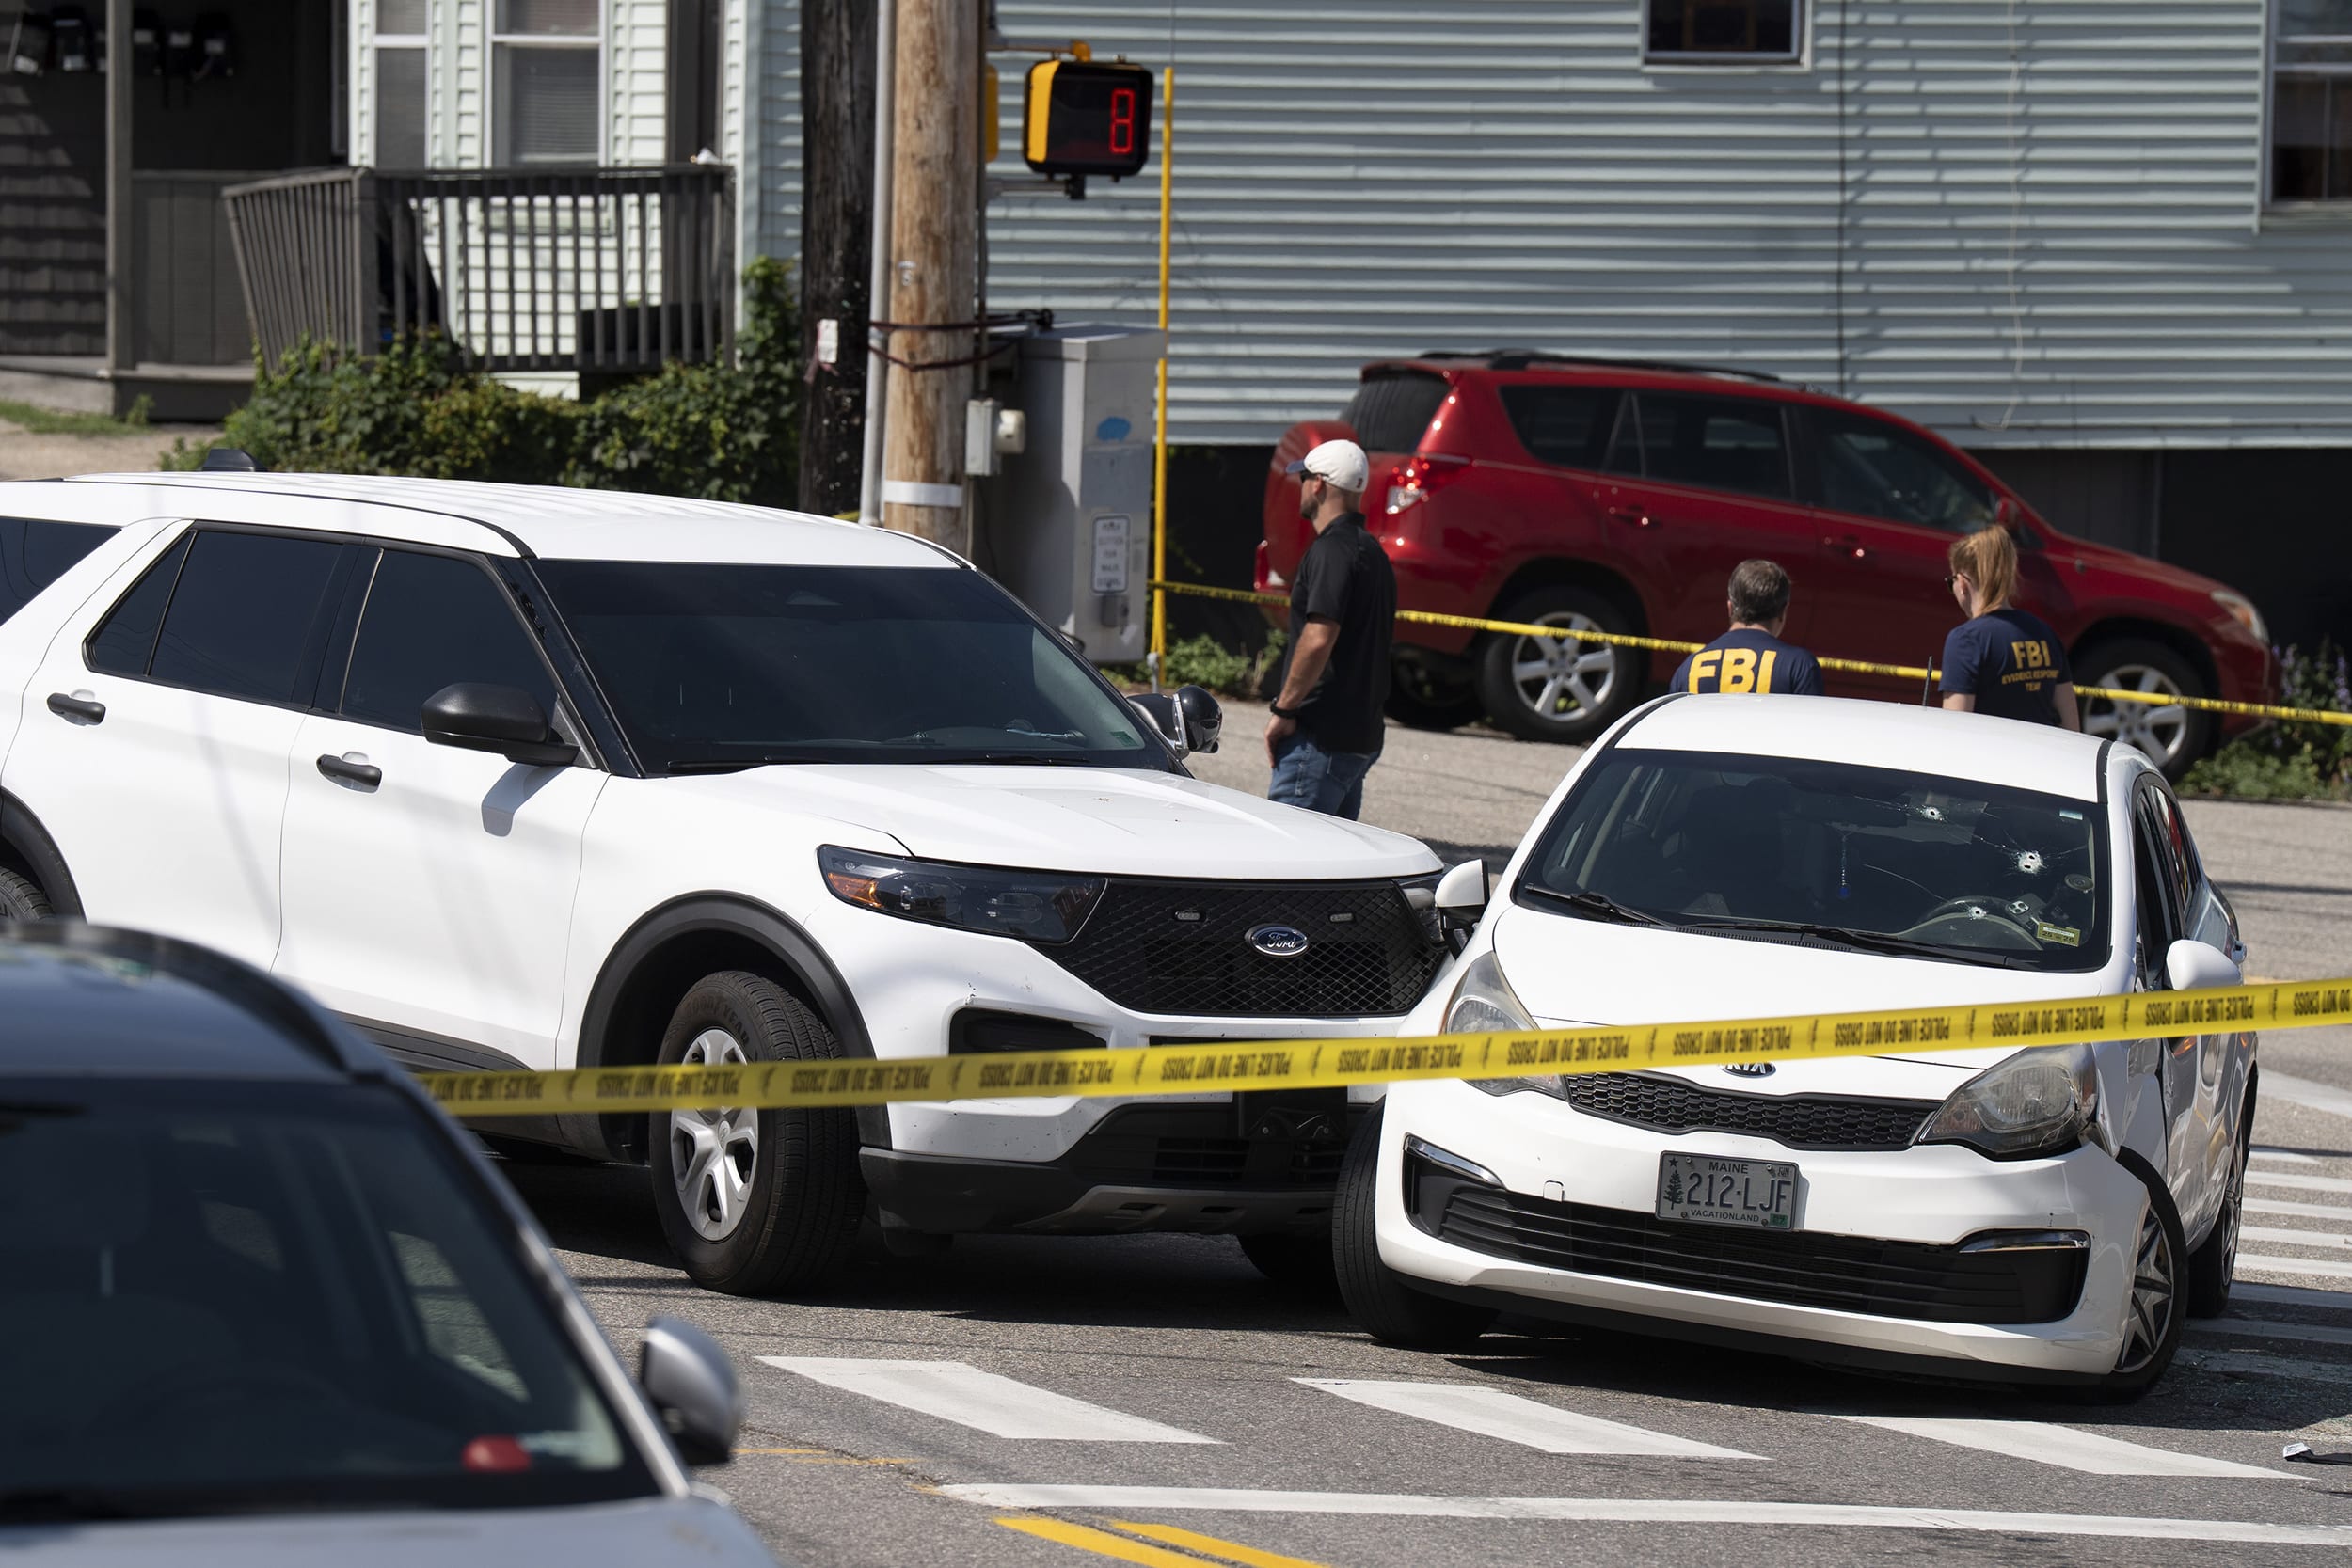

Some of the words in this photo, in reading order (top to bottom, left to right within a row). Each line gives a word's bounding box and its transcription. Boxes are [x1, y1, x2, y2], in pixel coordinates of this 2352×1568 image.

[1109, 87, 1136, 154] 8
[2011, 641, 2051, 669] FBI
[1689, 648, 1777, 694] FBI
[1266, 931, 1296, 949] Ford
[2174, 1000, 2190, 1023] NOT
[2192, 999, 2204, 1022] DO
[2206, 998, 2224, 1022] LINE
[2226, 996, 2255, 1020] POLICE
[2294, 991, 2320, 1015] CROSS
[2322, 990, 2338, 1014] NOT
[1992, 1013, 2020, 1037] CROSS
[2022, 1011, 2039, 1035] NOT
[2041, 1010, 2053, 1034] DO
[2055, 1008, 2074, 1033] LINE
[2075, 1006, 2105, 1030] POLICE
[2145, 1003, 2172, 1025] CROSS
[1740, 1028, 1758, 1052] LINE
[1761, 1026, 1792, 1050] POLICE
[1835, 1023, 1863, 1046] CROSS
[1865, 1022, 1882, 1044] NOT
[1884, 1021, 1897, 1043] DO
[1899, 1019, 1917, 1042] LINE
[1920, 1017, 1950, 1040] POLICE
[1507, 1041, 1538, 1064] CROSS
[1540, 1039, 1557, 1063] NOT
[1559, 1038, 1574, 1061] DO
[1575, 1037, 1596, 1061] LINE
[1597, 1036, 1630, 1058] POLICE
[1673, 1032, 1703, 1054] CROSS
[1704, 1030, 1722, 1053] NOT
[1724, 1029, 1738, 1053] DO
[1216, 1055, 1232, 1079] DO
[1233, 1054, 1256, 1078] LINE
[1257, 1052, 1293, 1076] POLICE
[1337, 1050, 1369, 1071] CROSS
[1370, 1048, 1390, 1071] NOT
[1391, 1047, 1406, 1070] DO
[1406, 1046, 1429, 1069] LINE
[1430, 1043, 1464, 1068] POLICE
[1161, 1058, 1194, 1079] CROSS
[1196, 1056, 1216, 1079] NOT
[1708, 1162, 1749, 1174] MAINE
[1691, 1209, 1759, 1223] VACATIONLAND
